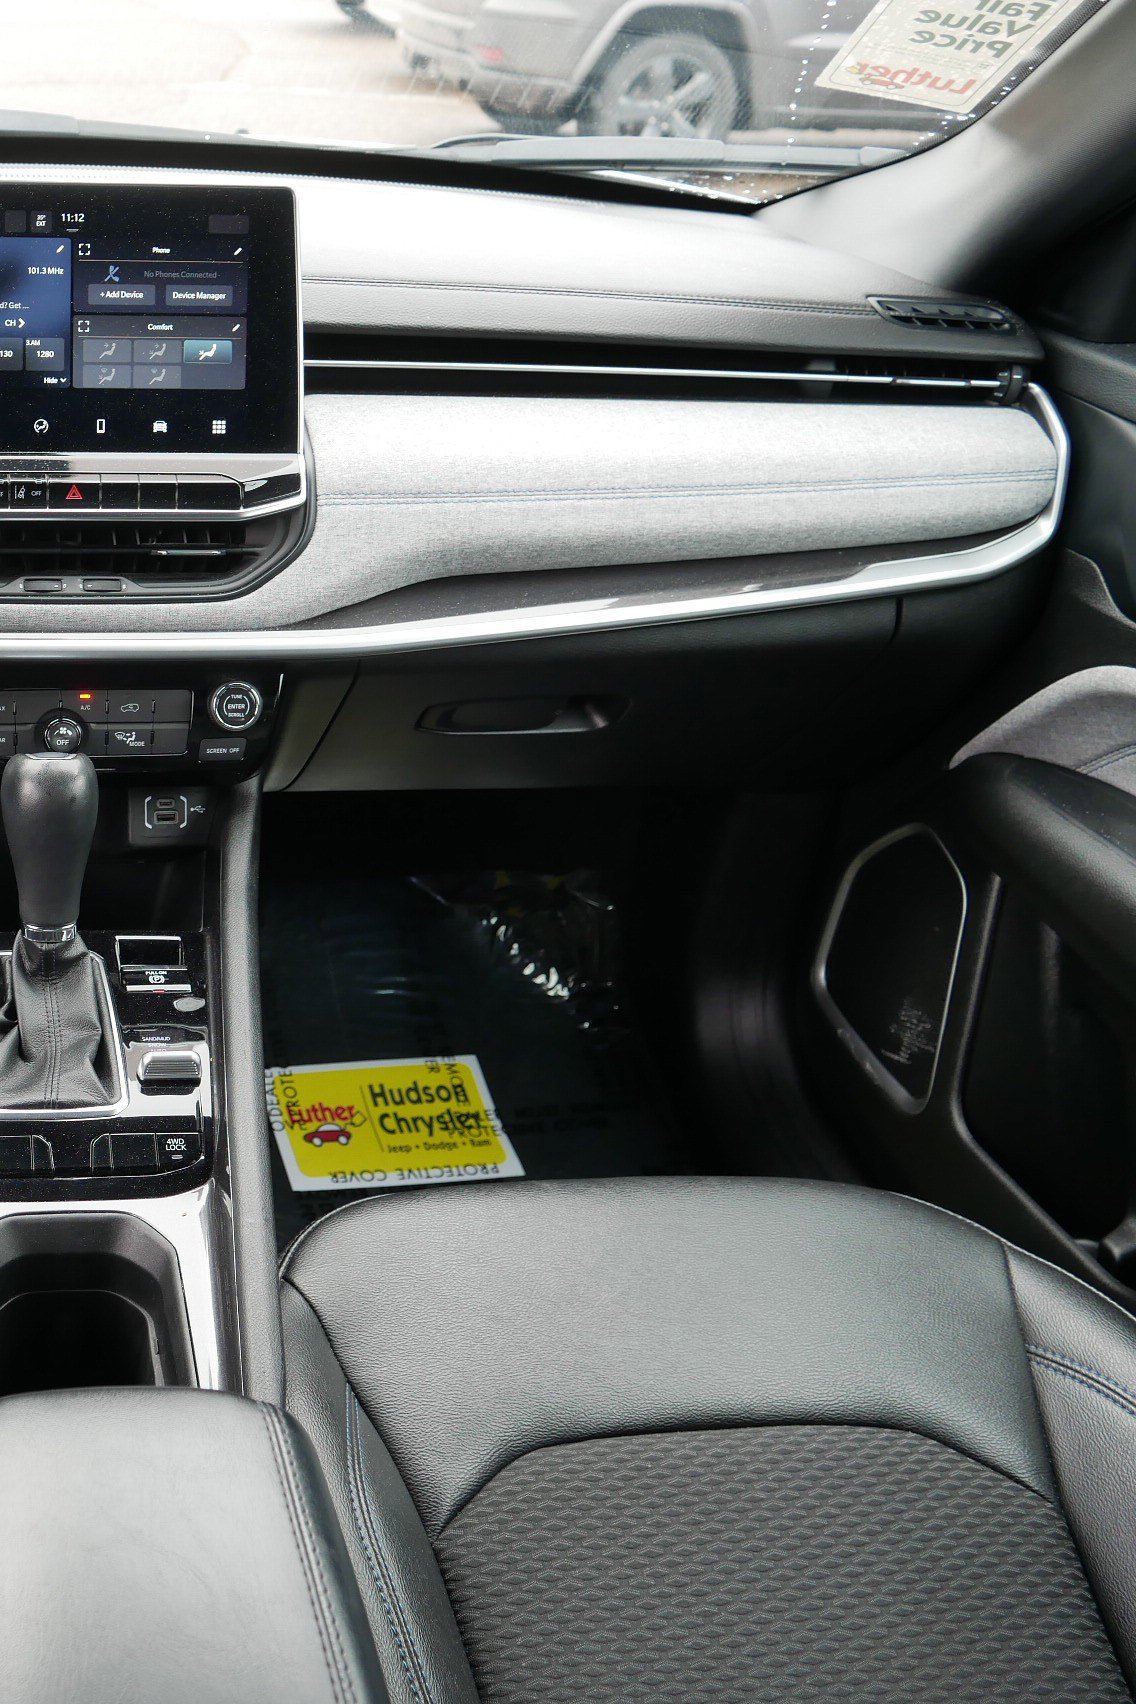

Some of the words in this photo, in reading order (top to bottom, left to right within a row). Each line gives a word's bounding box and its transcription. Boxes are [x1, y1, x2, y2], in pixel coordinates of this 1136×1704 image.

[61, 213, 85, 222] 11:12
[27, 267, 47, 275] 101.3
[47, 267, 65, 275] MHz
[144, 270, 154, 278] No
[156, 270, 180, 279] Phones
[180, 271, 217, 279] Connected
[120, 291, 144, 299] Device
[172, 291, 196, 299] Device
[196, 291, 227, 301] Manager
[5, 319, 16, 327] CH
[147, 323, 174, 331] Comfort
[367, 1080, 470, 1108] Hudson
[285, 1102, 355, 1125] Luther
[379, 1108, 483, 1138] Chrysler
[166, 1137, 185, 1145] 4WD
[386, 1143, 413, 1154] Jeep
[423, 1141, 459, 1152] Dodge
[470, 1138, 492, 1148] Ram
[328, 1167, 388, 1184] COVER
[397, 1161, 500, 1181] PROTECTIVE
